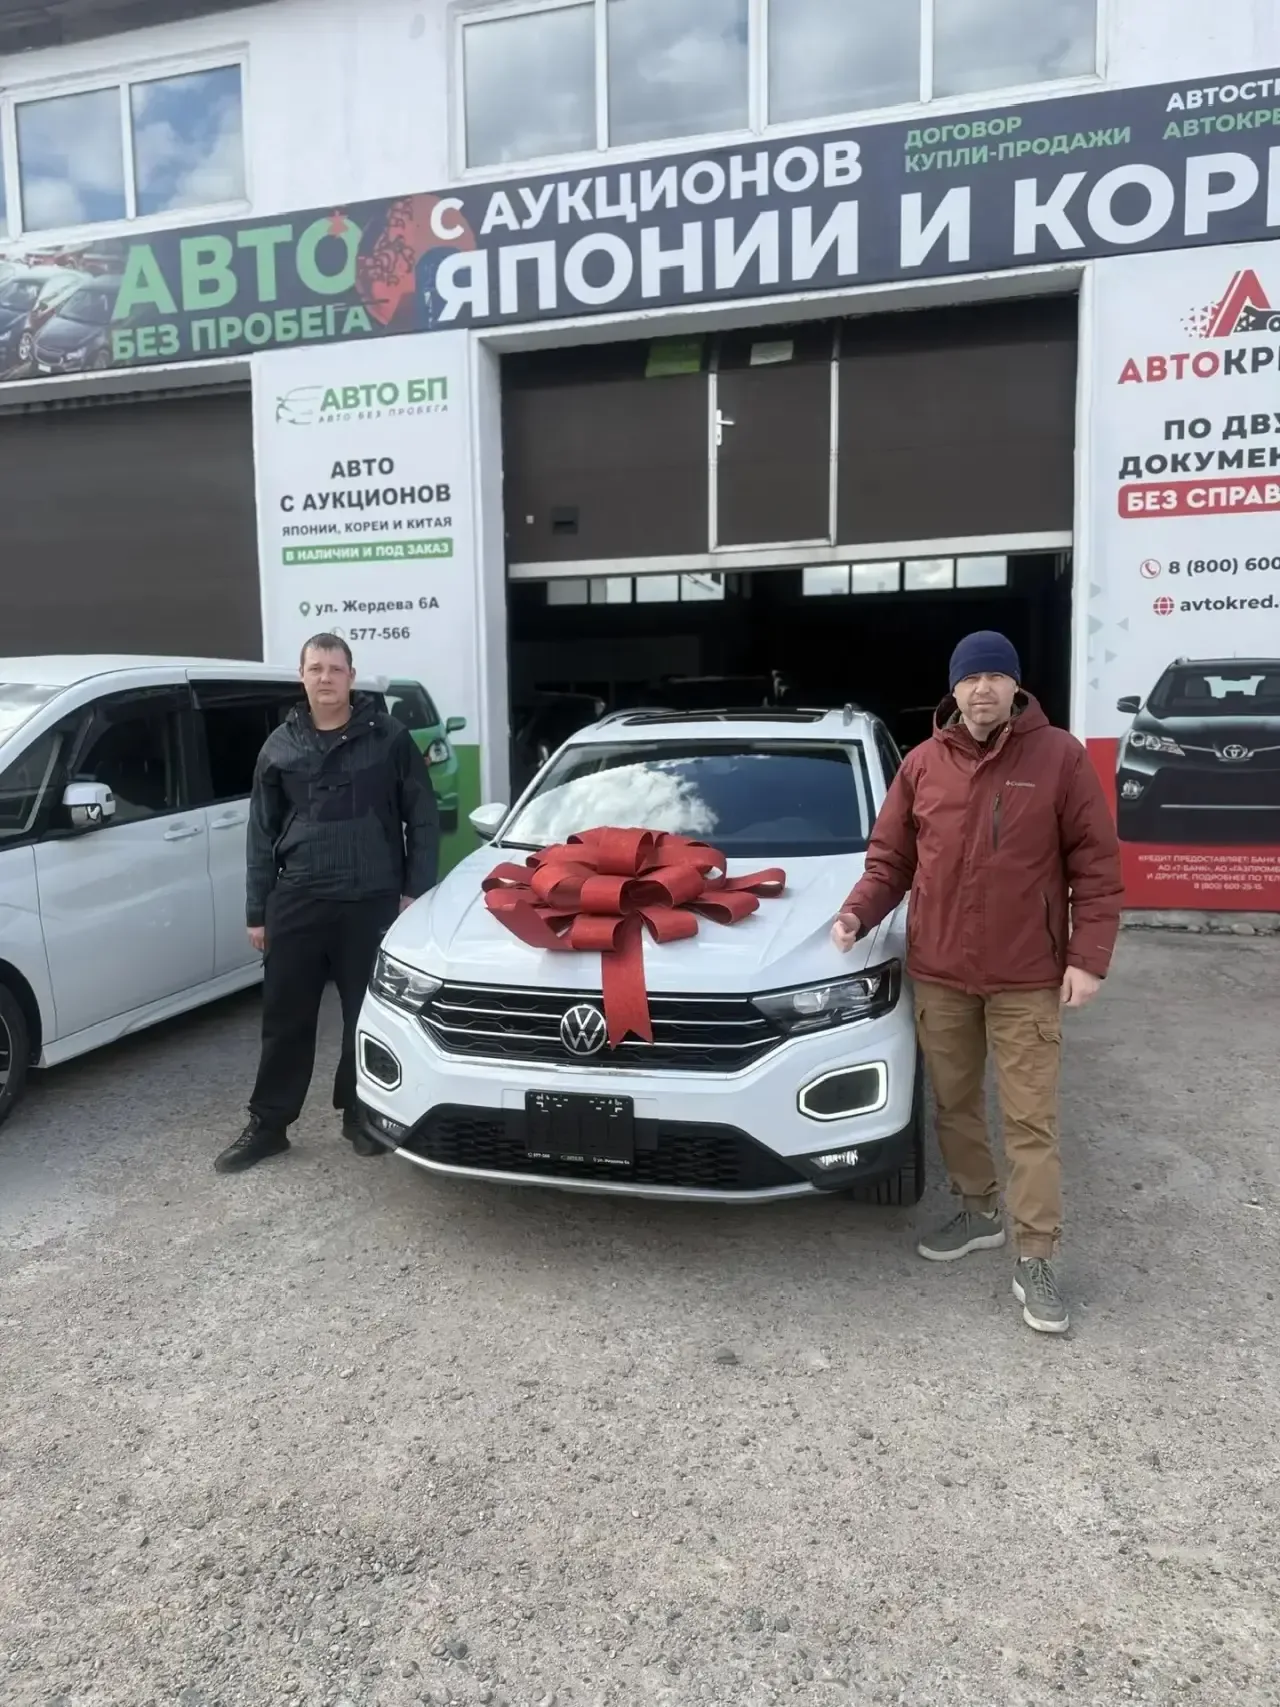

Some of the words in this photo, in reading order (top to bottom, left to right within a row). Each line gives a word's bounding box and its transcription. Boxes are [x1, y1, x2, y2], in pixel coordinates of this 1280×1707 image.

[904, 116, 1022, 150] ДОГОВОР
[904, 126, 1131, 173] КУПЛИ-ПРОДАЖИ
[430, 198, 464, 240] С
[480, 140, 862, 235] АУКЦИОНОВ
[435, 200, 859, 322] ЯПОНИИ
[900, 186, 970, 269] И
[1013, 146, 1280, 255] КОР
[111, 216, 363, 320] АВТО
[112, 324, 180, 361] БЕЗ
[192, 306, 371, 351] ПРОБЕГА
[1117, 345, 1280, 384] АВТОКР
[320, 382, 399, 412] АВТО
[407, 377, 448, 403] БП
[318, 413, 351, 424] АВТО
[358, 410, 381, 420] БЕЗ
[389, 404, 448, 416] ПРОБЕГА
[1164, 418, 1212, 440] ПО
[330, 457, 395, 479] АВТО
[1118, 447, 1280, 480] ДОКУМЕН
[280, 495, 294, 512] С
[302, 483, 451, 511] АУКЦИОНОВ
[1127, 489, 1178, 512] БЕЗ
[1186, 483, 1280, 508] СПРАВ
[282, 523, 341, 537] ЯПОНИИ,
[345, 521, 389, 533] КОРЕИ
[393, 520, 402, 529] И
[407, 516, 452, 529] КИТАЯ
[286, 551, 294, 561] В
[298, 548, 359, 561] НАЛИЧИИ
[363, 547, 372, 557] И
[376, 544, 404, 557] ПОД
[407, 542, 449, 555] ЗАКАЗ
[1168, 561, 1180, 574] 8
[1187, 558, 1238, 577] (800)
[1245, 557, 1280, 571] 600
[315, 602, 338, 616] ул.
[343, 598, 413, 615] Жердева
[418, 597, 439, 609] 6А
[350, 627, 410, 640] 577-566
